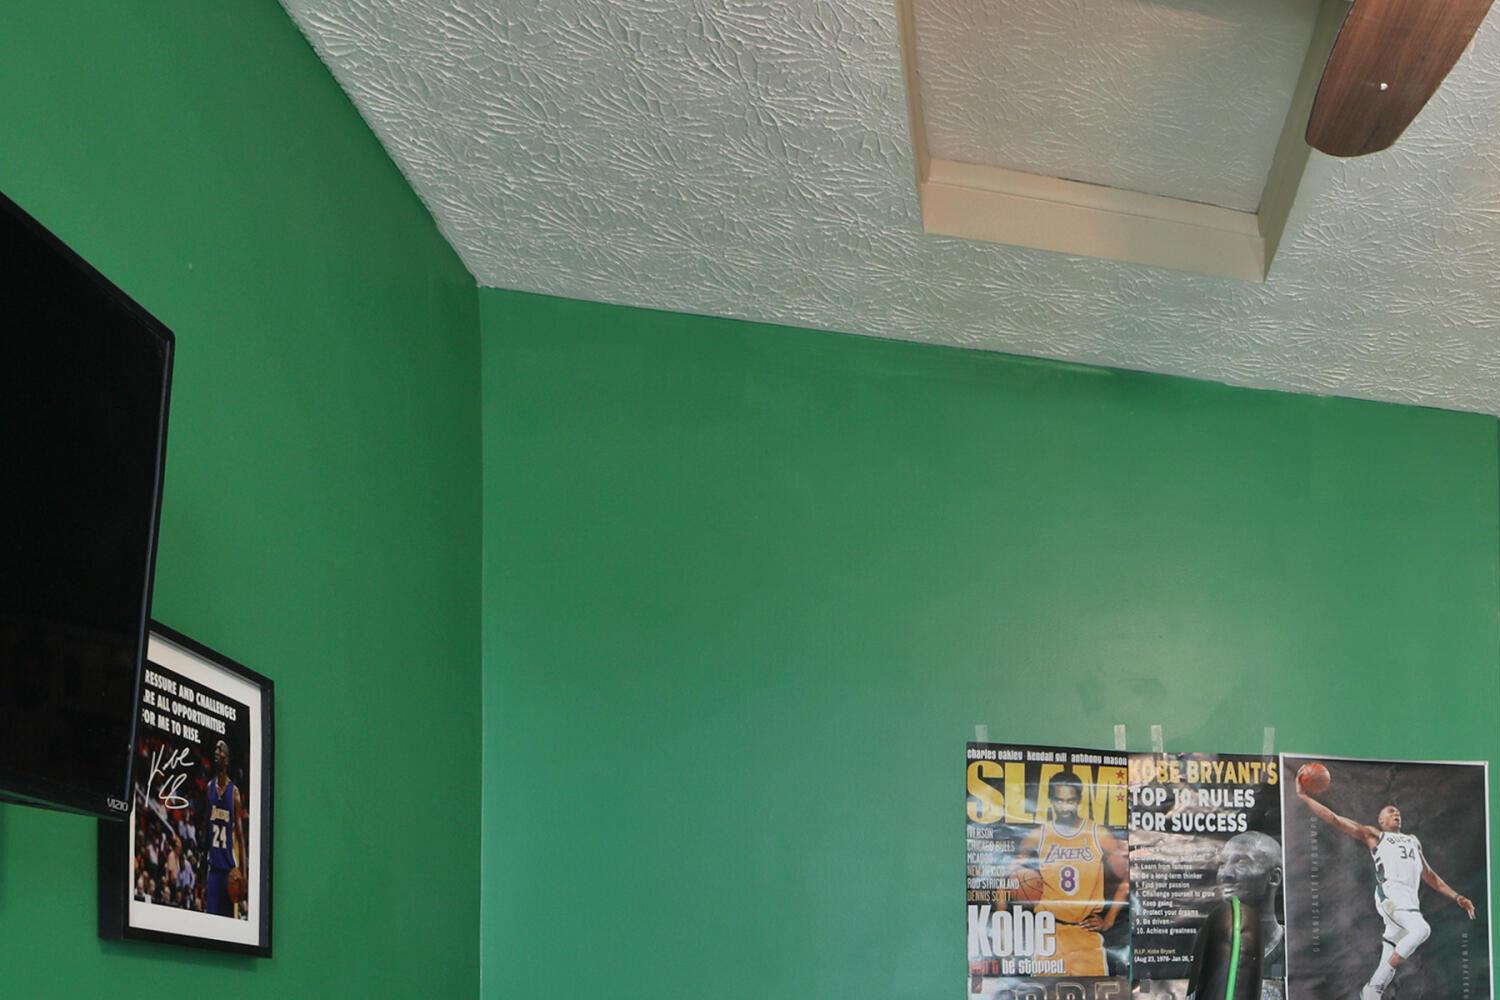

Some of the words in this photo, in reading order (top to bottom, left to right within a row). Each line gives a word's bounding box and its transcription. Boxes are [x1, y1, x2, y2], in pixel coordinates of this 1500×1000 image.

[145, 669, 177, 696] RESSURE
[179, 685, 195, 703] AND
[196, 692, 237, 721] CHALLENGES
[157, 694, 170, 712] ALL
[171, 701, 226, 735] OPPORTUNITIES
[157, 714, 170, 732] ME
[171, 719, 181, 736] TO
[183, 724, 201, 743] RISE.
[967, 748, 996, 760] charles
[998, 750, 1023, 761] oakley
[1027, 751, 1054, 762] kendall
[1071, 753, 1101, 764] anthony
[1103, 755, 1128, 766] mason
[1128, 760, 1180, 783] KOBE
[1187, 761, 1279, 785] BRYANT'S
[967, 760, 1127, 826] SLAM
[1131, 788, 1167, 806] TOP
[1172, 788, 1191, 807] 10
[1199, 788, 1255, 808] RULES
[107, 797, 128, 812] VIZIO
[1131, 812, 1166, 831] FOR
[1171, 813, 1248, 832] SUCCESS
[212, 824, 227, 849] 24
[1044, 844, 1094, 864] LAKERS
[1398, 846, 1416, 861] 34
[1061, 867, 1076, 892] 8
[968, 905, 1056, 957] Kobe
[1170, 928, 1197, 936] greatness
[1002, 959, 1015, 975] be
[1018, 958, 1066, 976] stopped.
